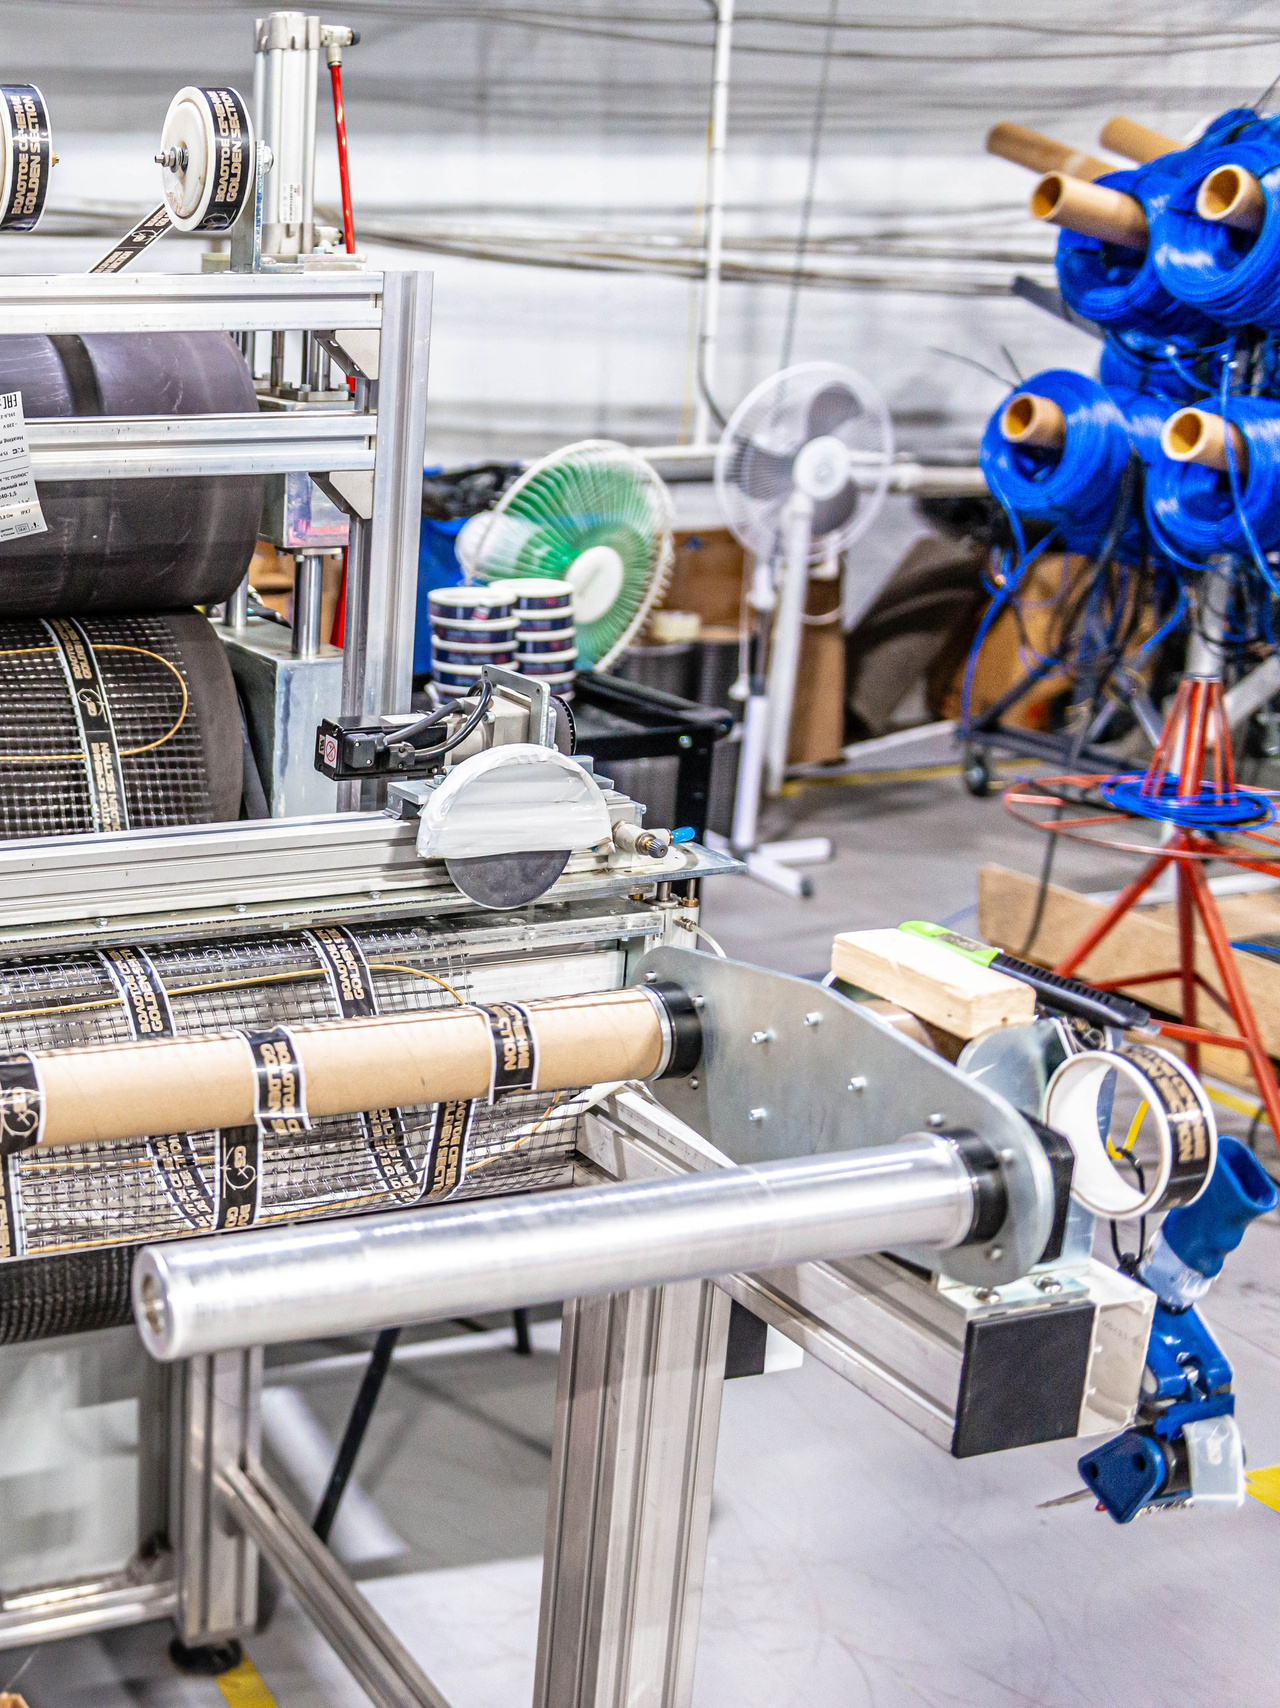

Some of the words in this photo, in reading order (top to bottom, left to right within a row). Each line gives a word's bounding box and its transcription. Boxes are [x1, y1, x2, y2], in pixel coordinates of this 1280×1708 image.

[21, 95, 41, 153] SECTION
[206, 91, 229, 137] СЕЧЕНИЕ
[217, 91, 242, 139] SECTION
[12, 153, 29, 214] ЗОЛОТОЕ
[23, 155, 41, 214] GOLDEN
[215, 138, 231, 202] ЗОЛОТОЕ
[226, 141, 243, 202] GOLDEN
[100, 742, 116, 792] SECTION
[325, 944, 354, 1000] ЗОЛОТОЕ
[337, 944, 365, 999] GOLDEN
[123, 974, 151, 1033] ЗОЛОТОЕ
[136, 974, 163, 1032] GOLDEN
[260, 1043, 282, 1114] GOLDEN
[273, 1041, 295, 1114] ЗОЛОТОЕ
[450, 1101, 467, 1145] ЛОТОЕ
